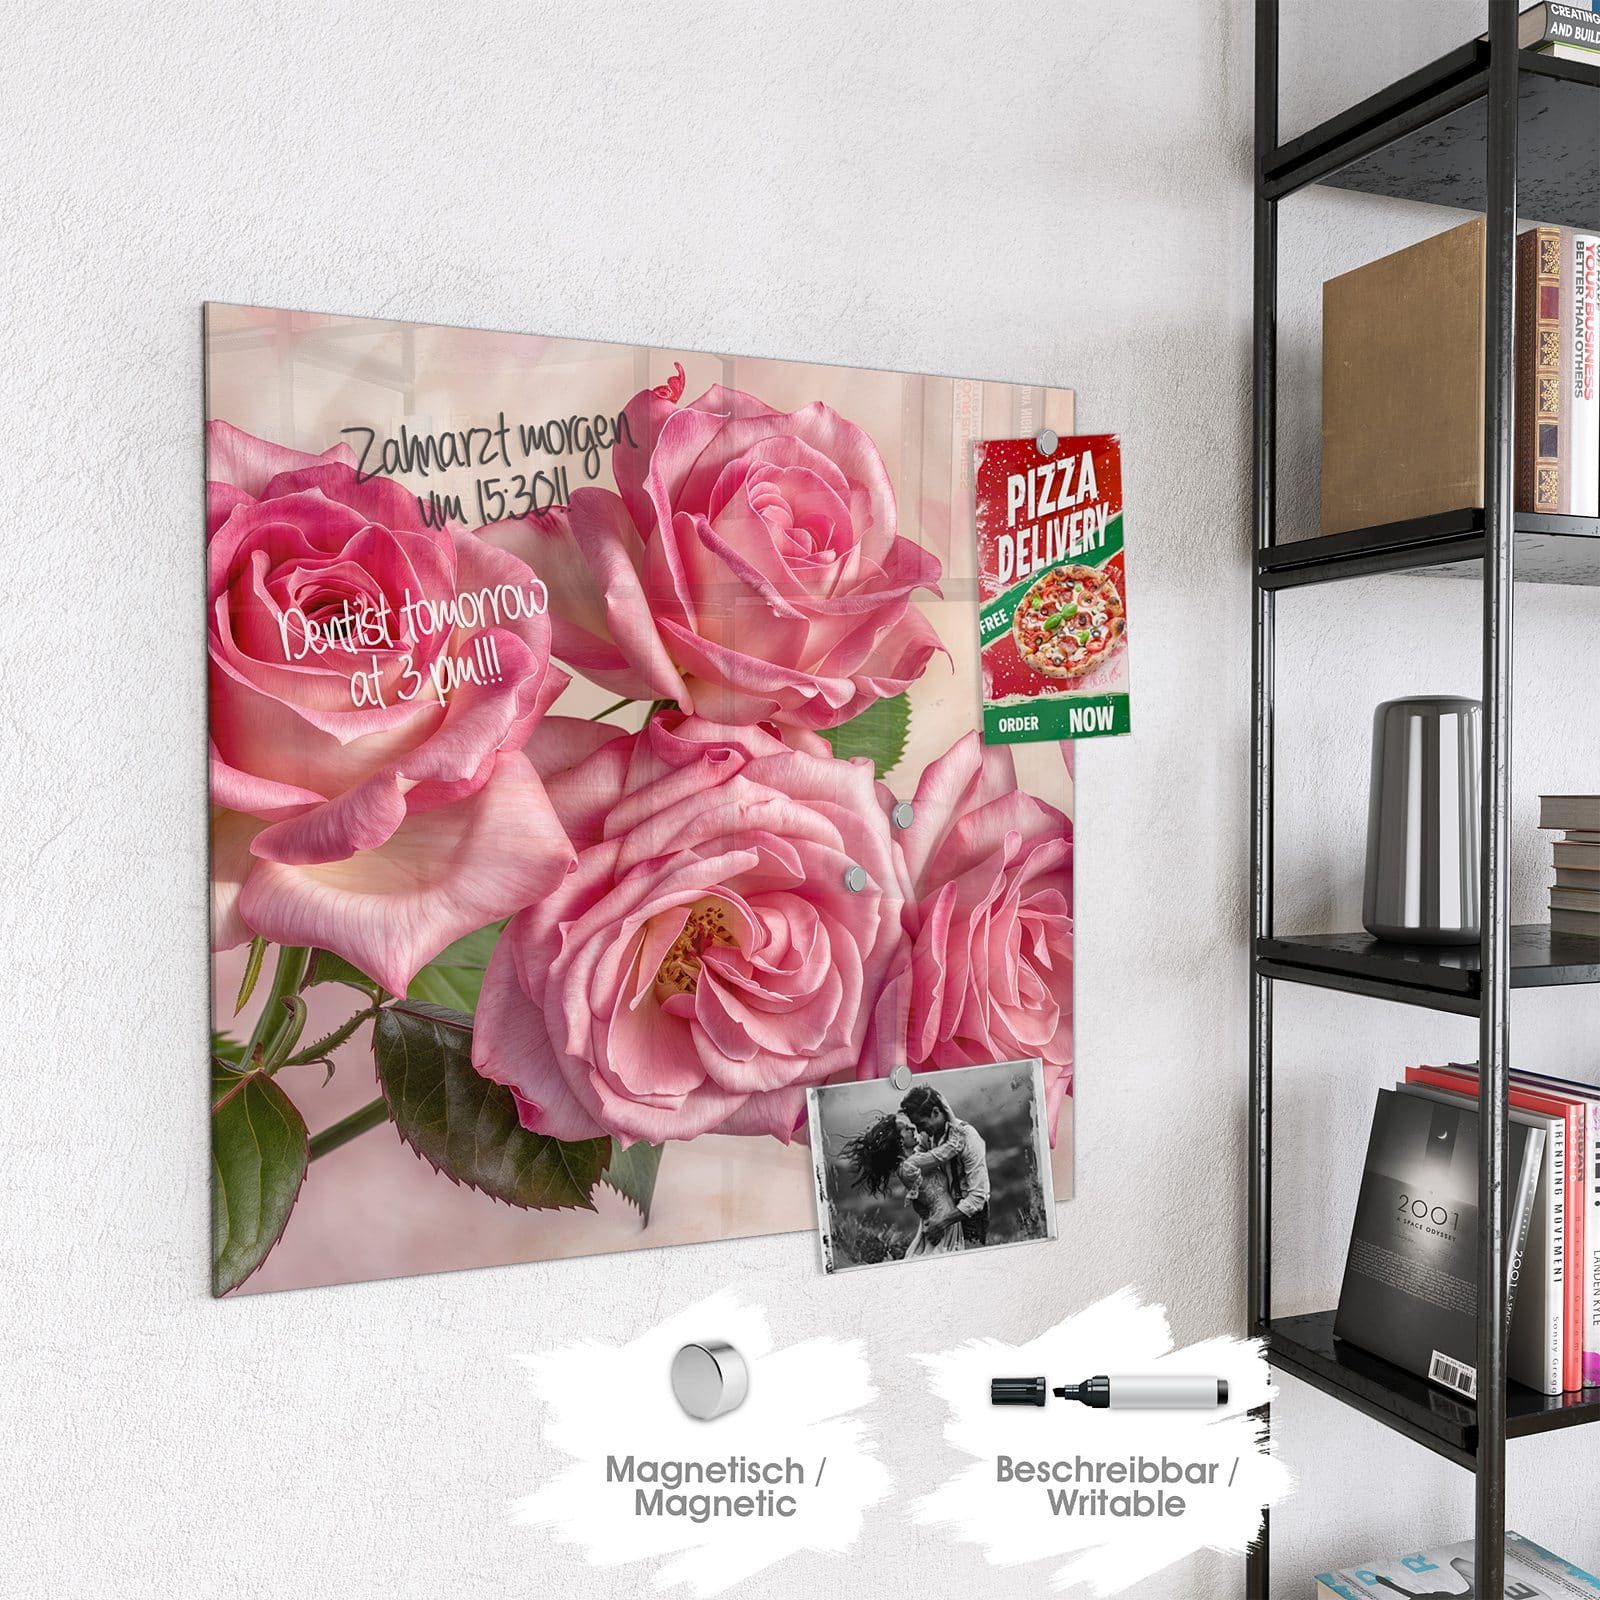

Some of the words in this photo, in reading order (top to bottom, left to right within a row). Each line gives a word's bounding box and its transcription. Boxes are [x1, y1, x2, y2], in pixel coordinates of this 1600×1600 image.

[1550, 21, 1573, 37] AND
[1551, 3, 1600, 25] CREATING
[1575, 240, 1584, 296] BETTER
[1585, 242, 1595, 299] YOUR
[1575, 297, 1584, 338] THAN
[1574, 340, 1584, 399] OTHERS
[1584, 302, 1595, 401] BUSINESS
[341, 411, 512, 485] Zahnarzt
[519, 410, 639, 480] morgen
[417, 489, 468, 532] um
[1007, 449, 1099, 528] PIZZA
[997, 501, 1110, 584] DELIVERY
[277, 592, 395, 662] Dentist
[399, 578, 549, 644] tomorrow
[979, 608, 1010, 635] FREE
[350, 654, 387, 710] at
[396, 653, 423, 701] 3
[430, 634, 504, 708] pm!!!
[998, 715, 1040, 733] ORDER
[1069, 705, 1115, 734] NOW
[1553, 1123, 1564, 1196] TRENDING
[1397, 1194, 1460, 1231] 2001
[1402, 1217, 1423, 1231] SPACE
[1425, 1226, 1457, 1242] ODYSSEY
[1553, 1203, 1563, 1283] MOVEMENT
[1508, 1249, 1523, 1287] 2001
[1551, 1315, 1560, 1353] Sonny
[1592, 1299, 1600, 1327] KYLE
